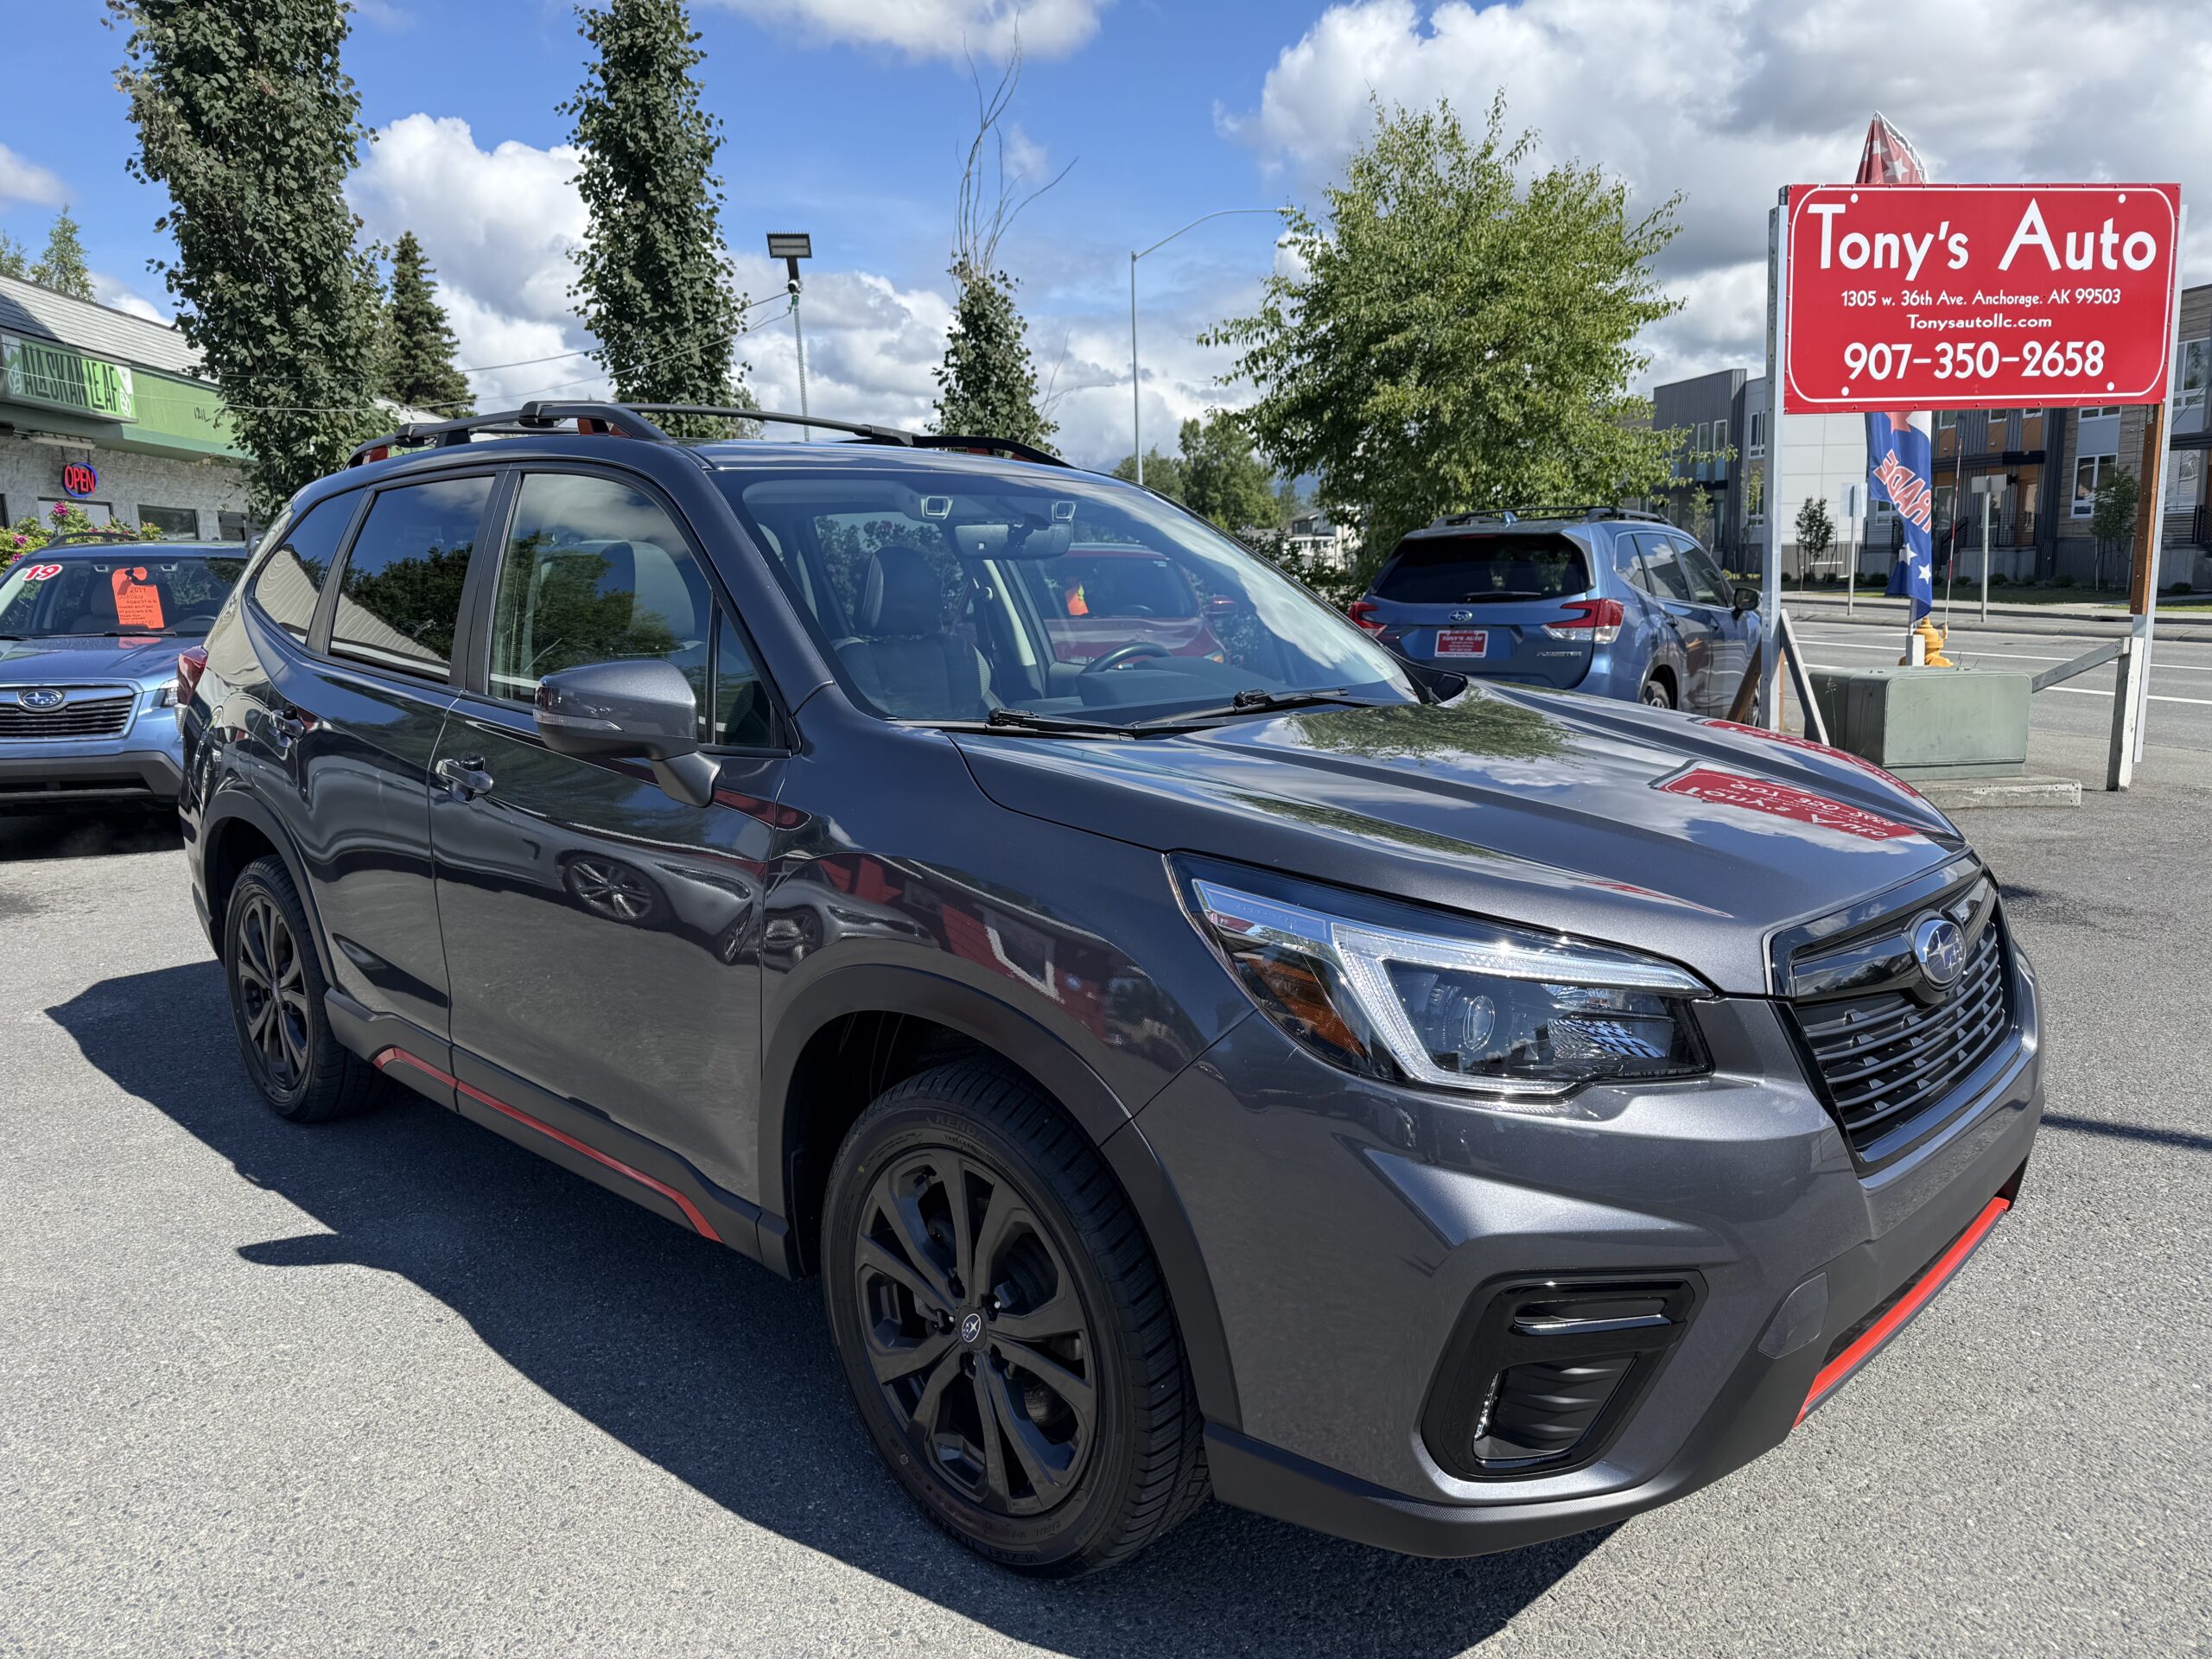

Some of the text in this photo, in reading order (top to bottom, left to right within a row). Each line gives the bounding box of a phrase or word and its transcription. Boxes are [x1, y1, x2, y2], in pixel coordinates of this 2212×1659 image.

[1807, 197, 2158, 282] Tony's Auto
[1841, 288, 2122, 308] 1305 w. 36th Ave. Anchorage. AK 99503
[1906, 313, 2052, 332] Tonysautollc.com
[1843, 340, 2106, 381] 907-350-2658
[21, 344, 118, 412] ALASKAN LEAF
[64, 465, 96, 494] OPEN
[22, 563, 64, 582] 19
